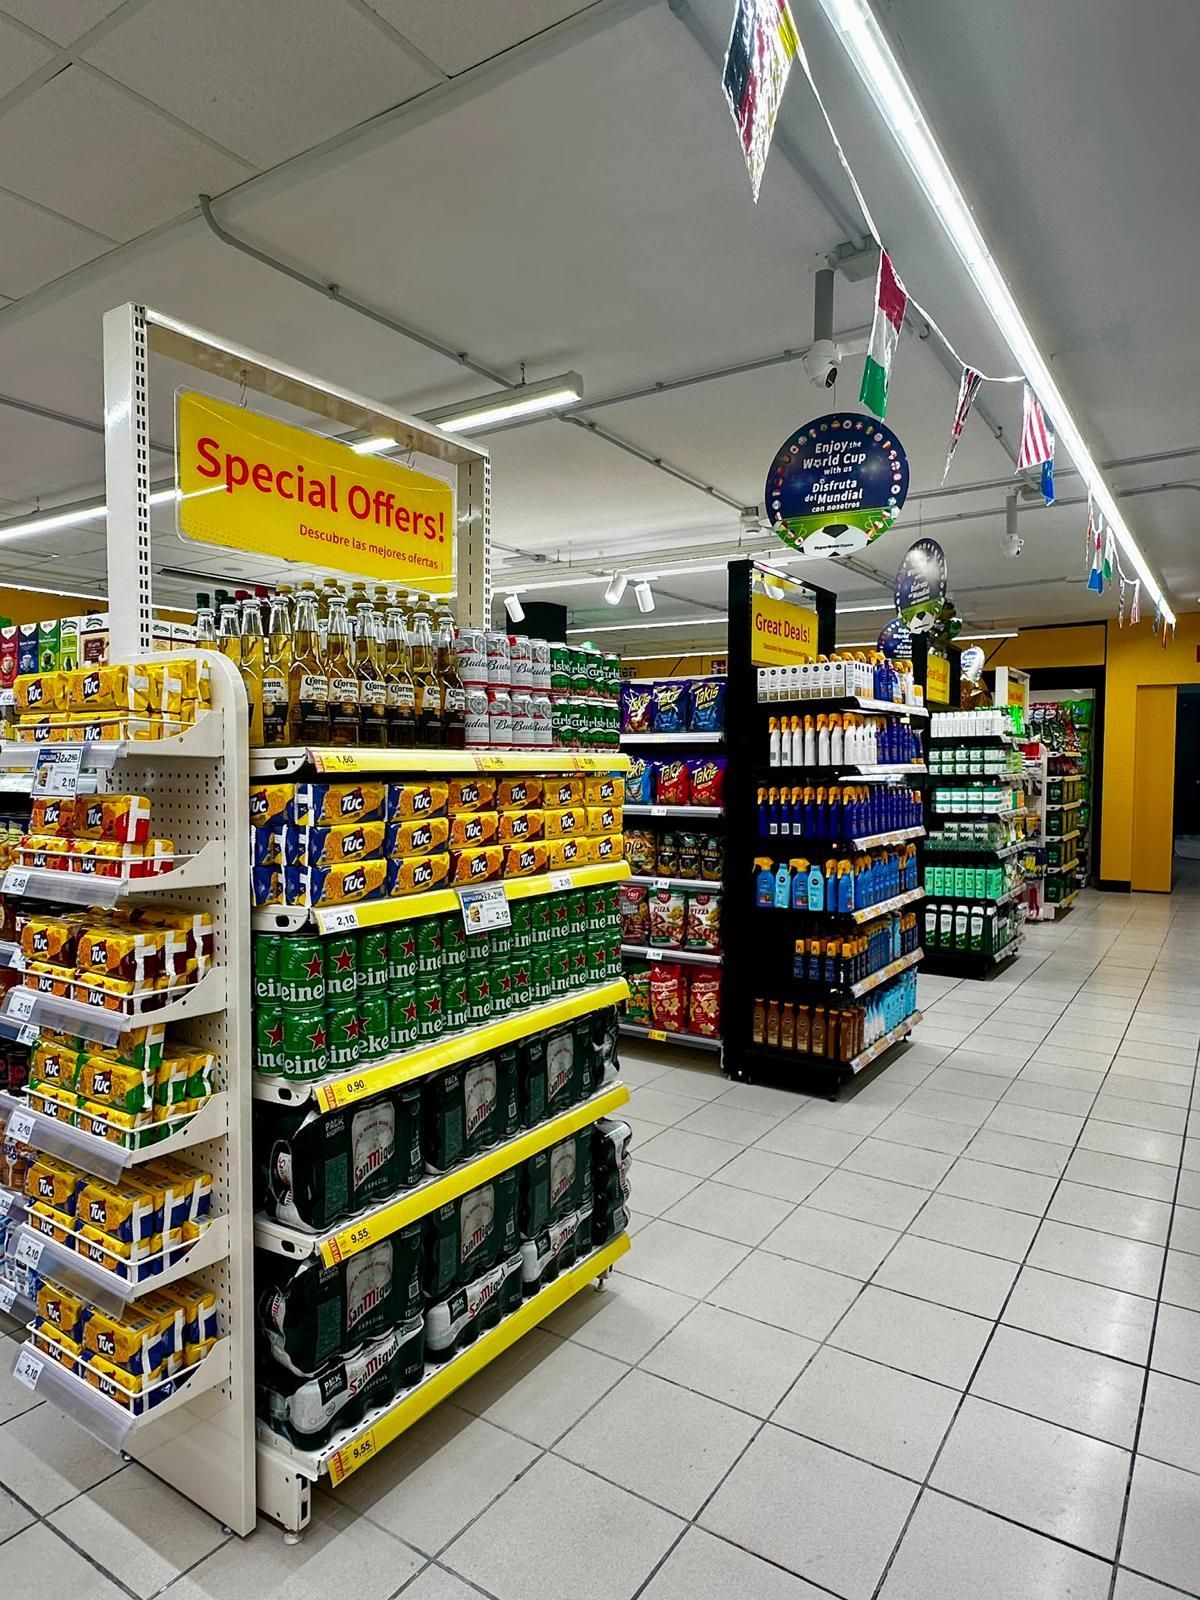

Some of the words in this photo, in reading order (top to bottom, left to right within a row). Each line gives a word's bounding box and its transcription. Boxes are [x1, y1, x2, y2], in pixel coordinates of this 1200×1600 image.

[815, 440, 848, 455] Enjoy
[849, 441, 862, 449] the
[802, 454, 839, 470] World
[843, 452, 867, 466] Cup
[823, 467, 842, 476] with
[196, 436, 338, 514] Special
[347, 484, 445, 544] Offers!
[812, 479, 857, 494] Disfruta
[804, 492, 817, 502] del
[817, 489, 863, 505] Mundial
[811, 505, 825, 513] con
[826, 501, 860, 512] nosotros
[299, 523, 350, 548] Descubre
[351, 537, 367, 552] las
[368, 544, 407, 564] mejores
[407, 550, 438, 571] ofertas
[755, 612, 782, 635] Great
[784, 620, 811, 644] Deals!
[83, 677, 100, 694] TUC
[28, 685, 43, 702] TUC
[694, 685, 719, 705] Takis
[62, 777, 76, 788] 2,10
[692, 766, 718, 787] Takis
[461, 787, 478, 802] TUC
[511, 787, 527, 800] TUC
[559, 788, 572, 801] TUC
[600, 785, 613, 798] TUC
[342, 796, 363, 811] TUC
[413, 794, 431, 809] TUC
[44, 806, 60, 821] TUC
[87, 811, 103, 826] TUC
[601, 813, 615, 826] TUC
[512, 819, 529, 834] TUC
[561, 816, 576, 829] TUC
[412, 830, 430, 846] TUC
[465, 824, 483, 838] TUC
[342, 835, 364, 852] TUC
[564, 844, 578, 858] TUC
[599, 843, 613, 856] TUC
[471, 859, 488, 874] TUC
[520, 853, 536, 867] TUC
[343, 874, 364, 891] TUC
[414, 868, 431, 883] TUC
[336, 913, 355, 927] 2,10
[33, 934, 48, 951] TUC
[91, 948, 106, 964] TUC
[17, 1003, 31, 1015] 2,10
[44, 1060, 59, 1078] TUC
[93, 1074, 110, 1094] TUC
[347, 1079, 365, 1093] 0,90
[324, 1117, 345, 1132] PACK
[38, 1178, 54, 1196] TUC
[90, 1203, 106, 1222] TUC
[350, 1227, 369, 1244] 9,55
[25, 1246, 39, 1260] 2,10
[47, 1303, 61, 1322] TUC
[97, 1335, 114, 1354] TUC
[24, 1364, 38, 1379] 2,10
[353, 1440, 371, 1458] 9,55
